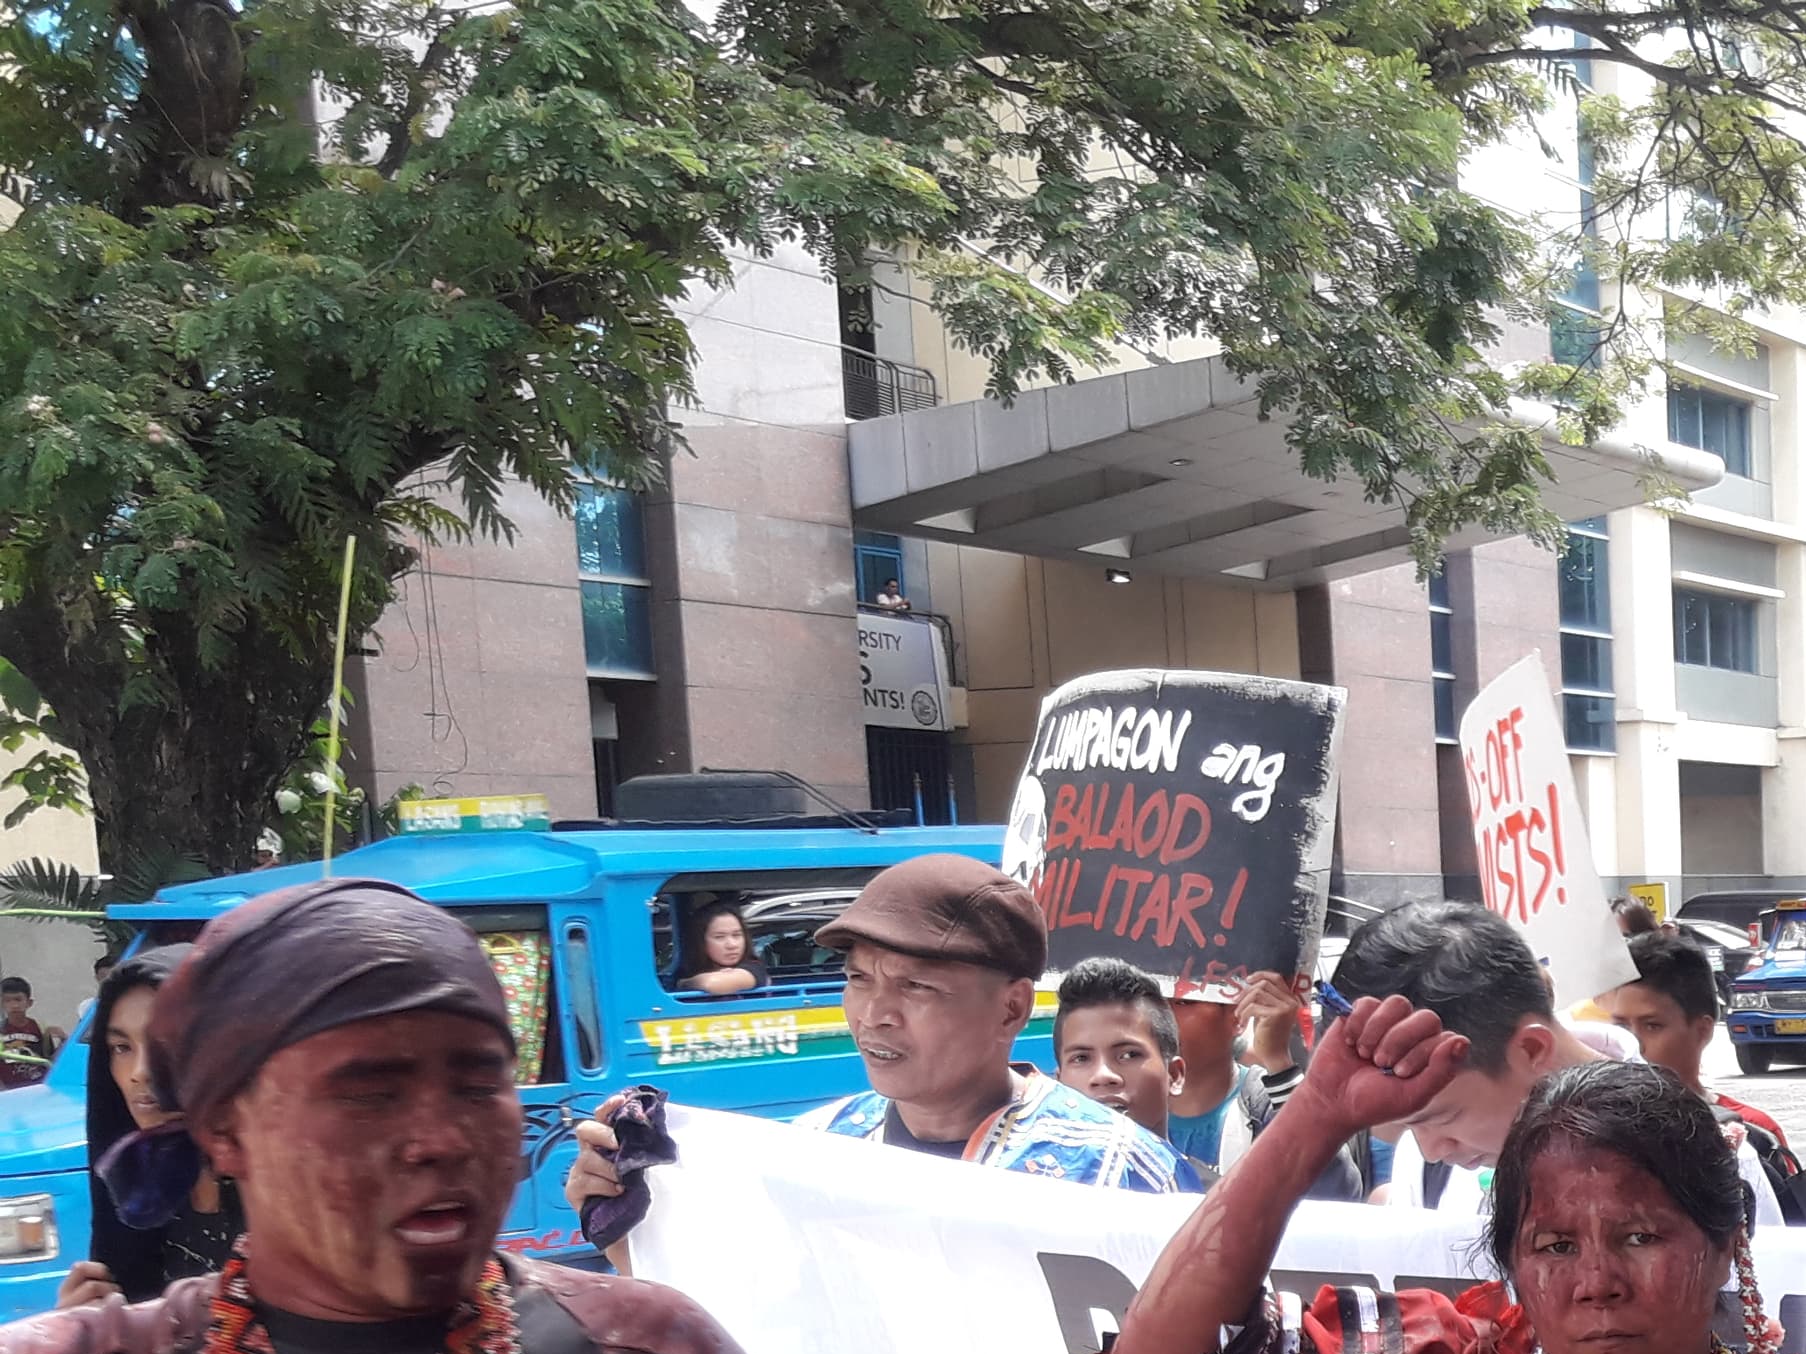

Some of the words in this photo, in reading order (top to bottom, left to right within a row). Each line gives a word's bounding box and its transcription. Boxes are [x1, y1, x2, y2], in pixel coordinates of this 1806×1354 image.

[1036, 705, 1192, 776] LUMPAGON
[1200, 742, 1286, 823] ang
[1044, 781, 1212, 865] BALAOD
[1027, 856, 1249, 949] MILITAR!
